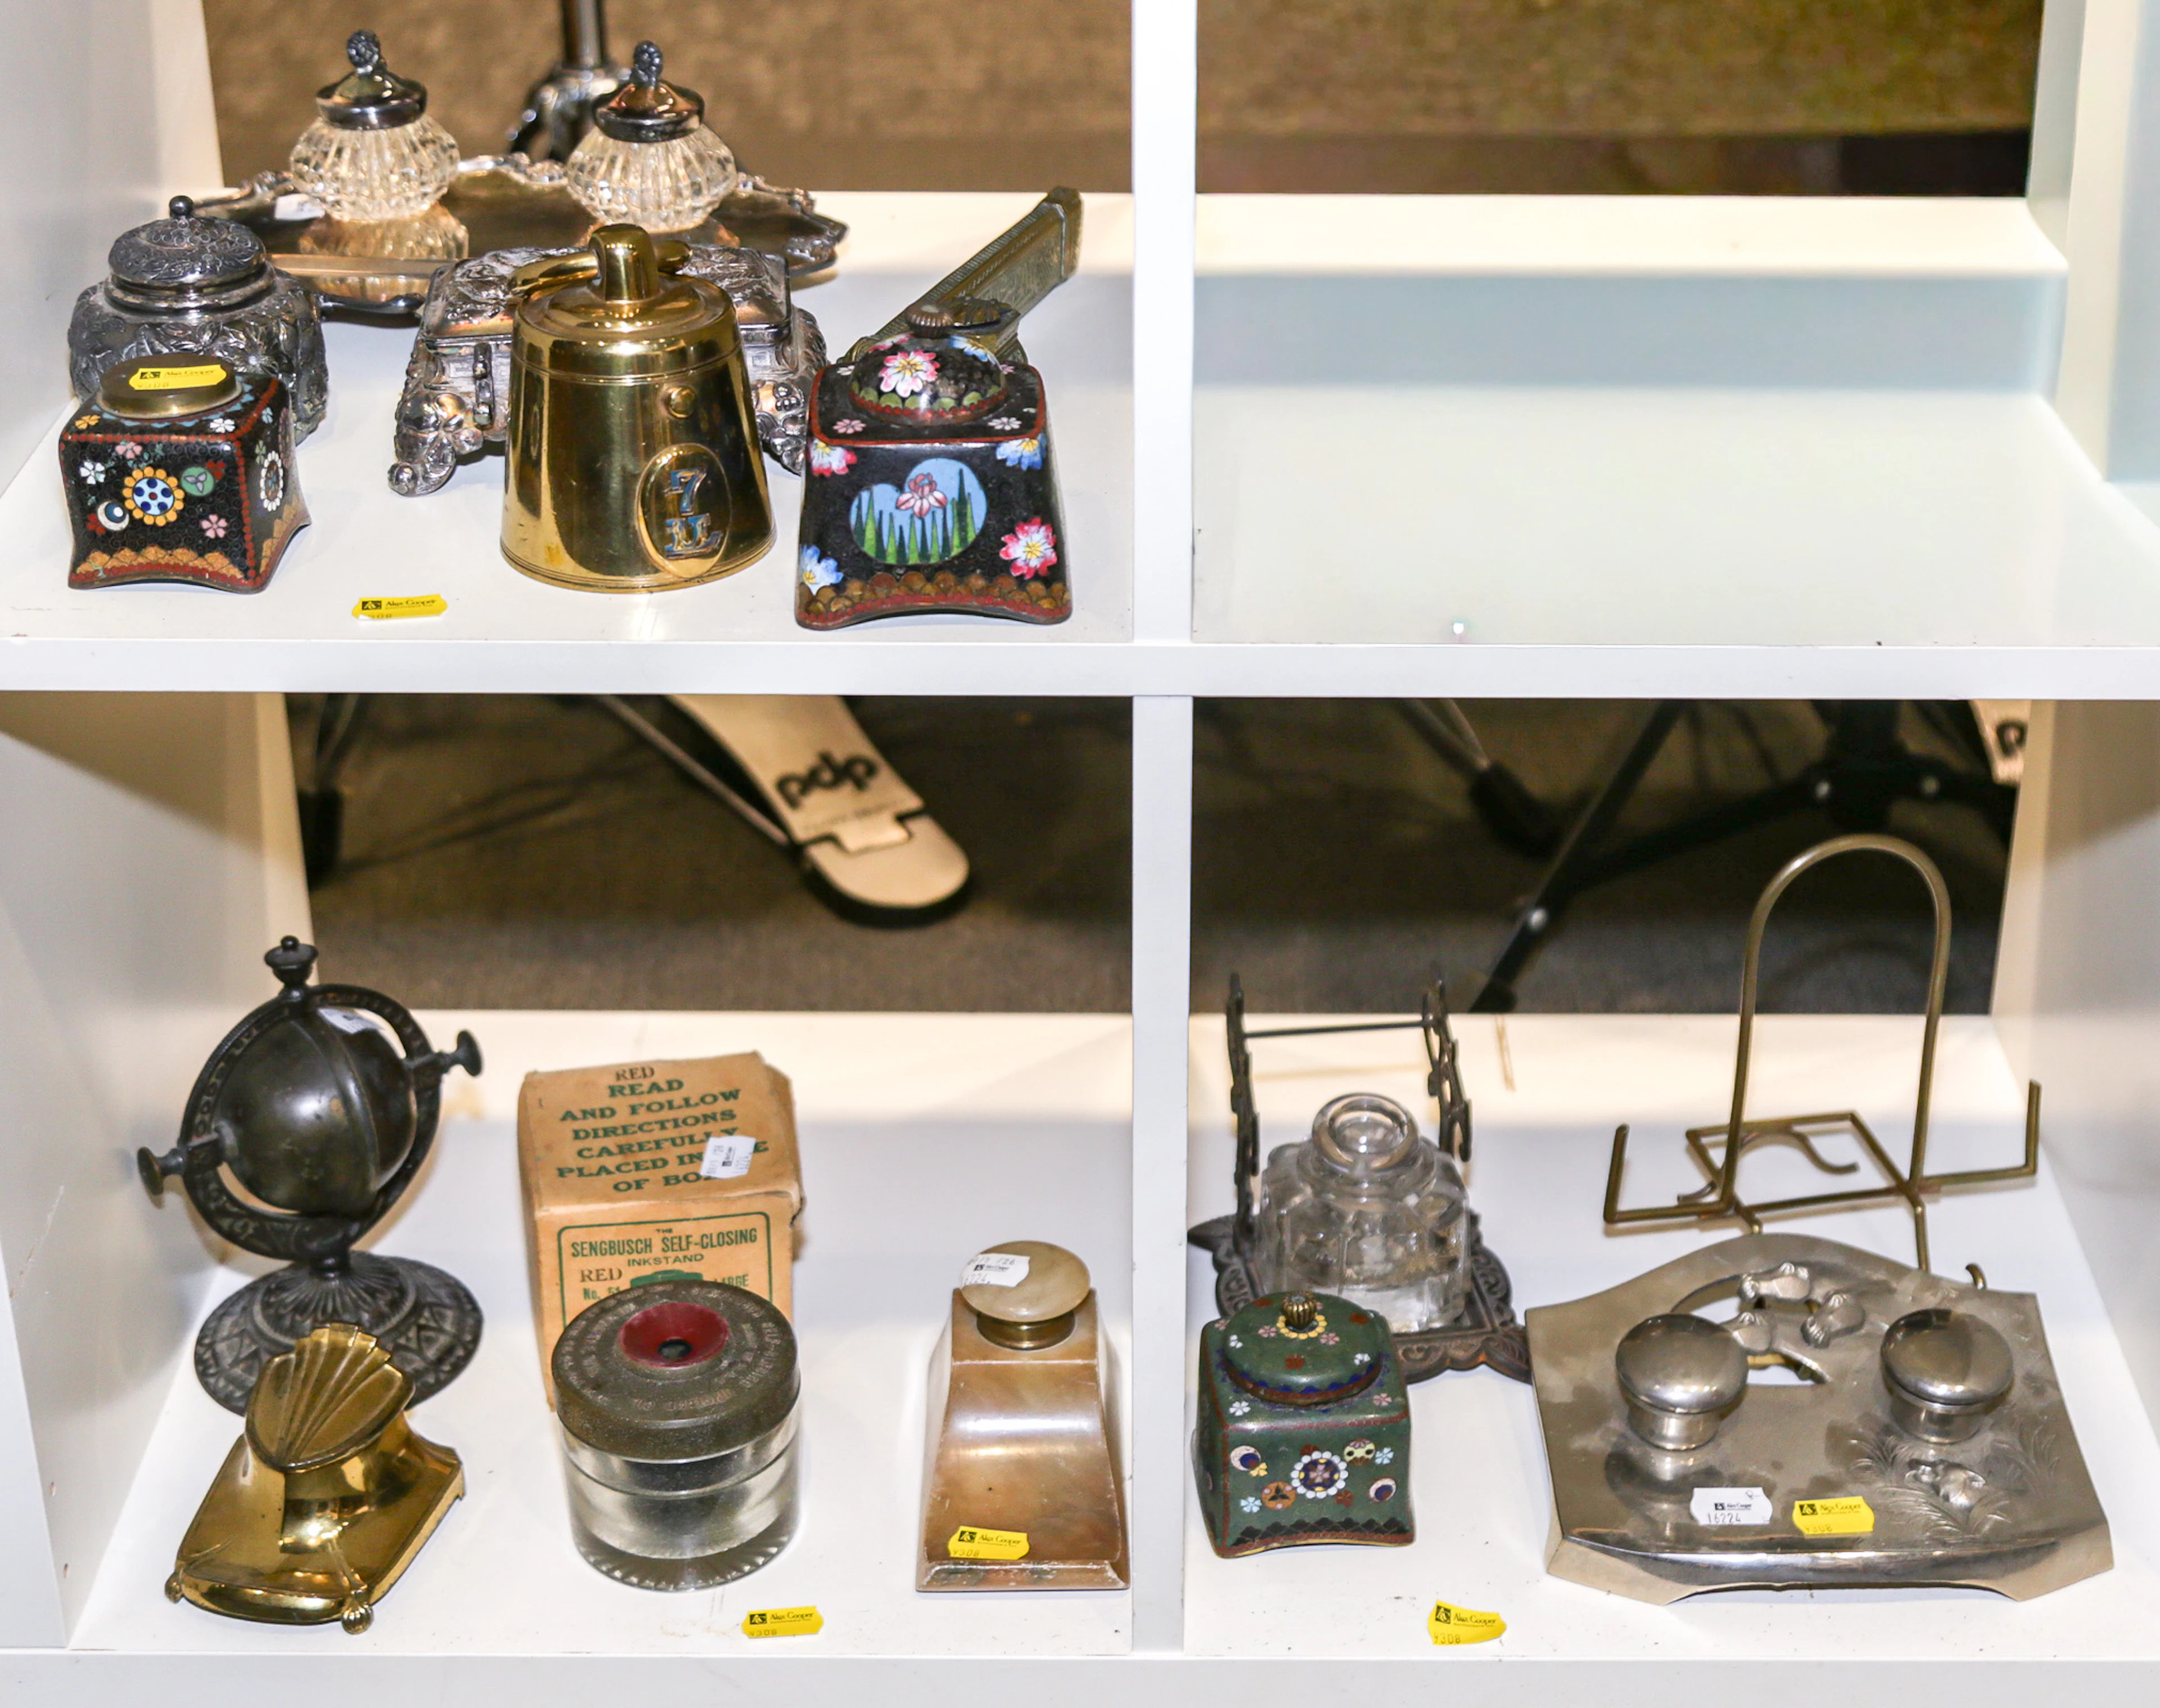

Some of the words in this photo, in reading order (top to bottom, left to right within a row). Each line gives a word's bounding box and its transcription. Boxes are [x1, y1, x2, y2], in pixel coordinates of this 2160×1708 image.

[775, 750, 879, 810] pdp
[616, 1065, 655, 1082] RED
[608, 1079, 685, 1098] READ
[560, 1106, 617, 1122] AND
[628, 1089, 742, 1116] FOLLOW
[572, 1109, 737, 1141] DIRECTIONS
[556, 1157, 669, 1178] PLACED
[613, 1179, 649, 1192] OF
[662, 1170, 719, 1186] BO
[571, 1238, 652, 1258] SENGBUSCH
[661, 1228, 758, 1253] SELF-CLOSING
[627, 1253, 704, 1267] INKSTAND
[580, 1267, 623, 1282] RED
[583, 1288, 601, 1301] No.
[1835, 1503, 1862, 1511] Cooper
[995, 1535, 1022, 1545] Cooper
[1454, 1613, 1469, 1622] Alex
[1470, 1615, 1497, 1625] Cooper
